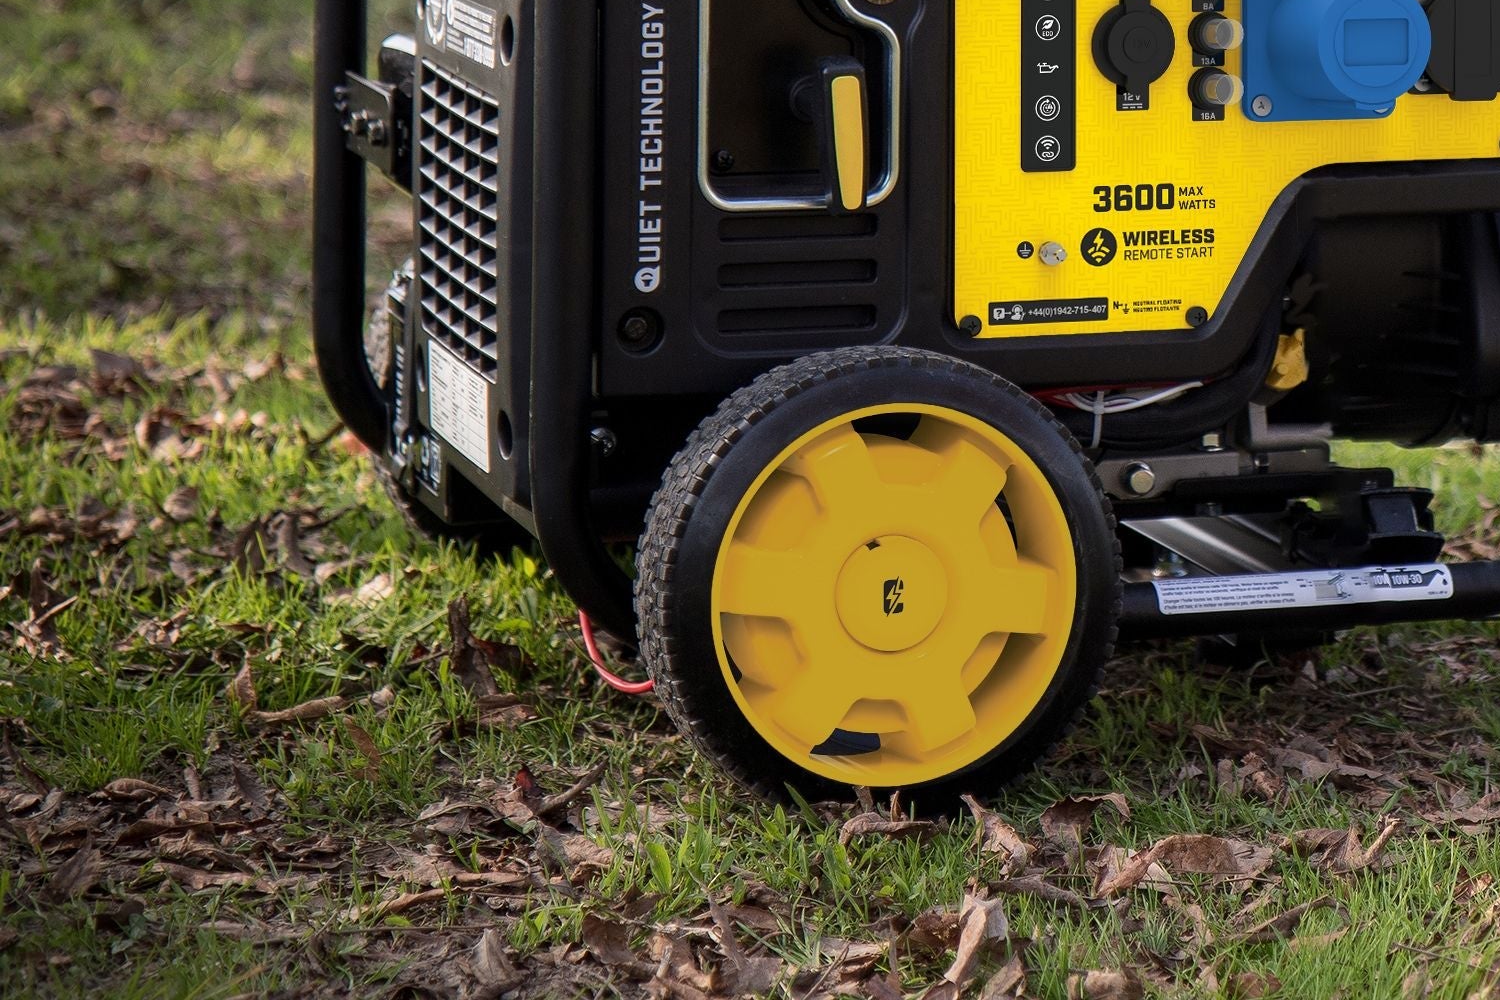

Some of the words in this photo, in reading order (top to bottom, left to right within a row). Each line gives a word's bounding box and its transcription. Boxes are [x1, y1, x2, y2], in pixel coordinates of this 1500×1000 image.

[1201, 57, 1216, 66] 13A
[639, 2, 665, 191] TECHNOLOGY
[1201, 112, 1216, 121] 16A
[1093, 182, 1175, 213] 3600
[1178, 186, 1204, 197] MAX
[1178, 199, 1216, 210] WATTS
[1122, 228, 1215, 247] WIRELESS
[634, 200, 662, 293] QUIET
[1124, 248, 1173, 261] REMOTE
[1176, 246, 1215, 259] START
[1028, 304, 1107, 317] +44(0)1942-715-407
[1391, 572, 1423, 586] 10W-30
